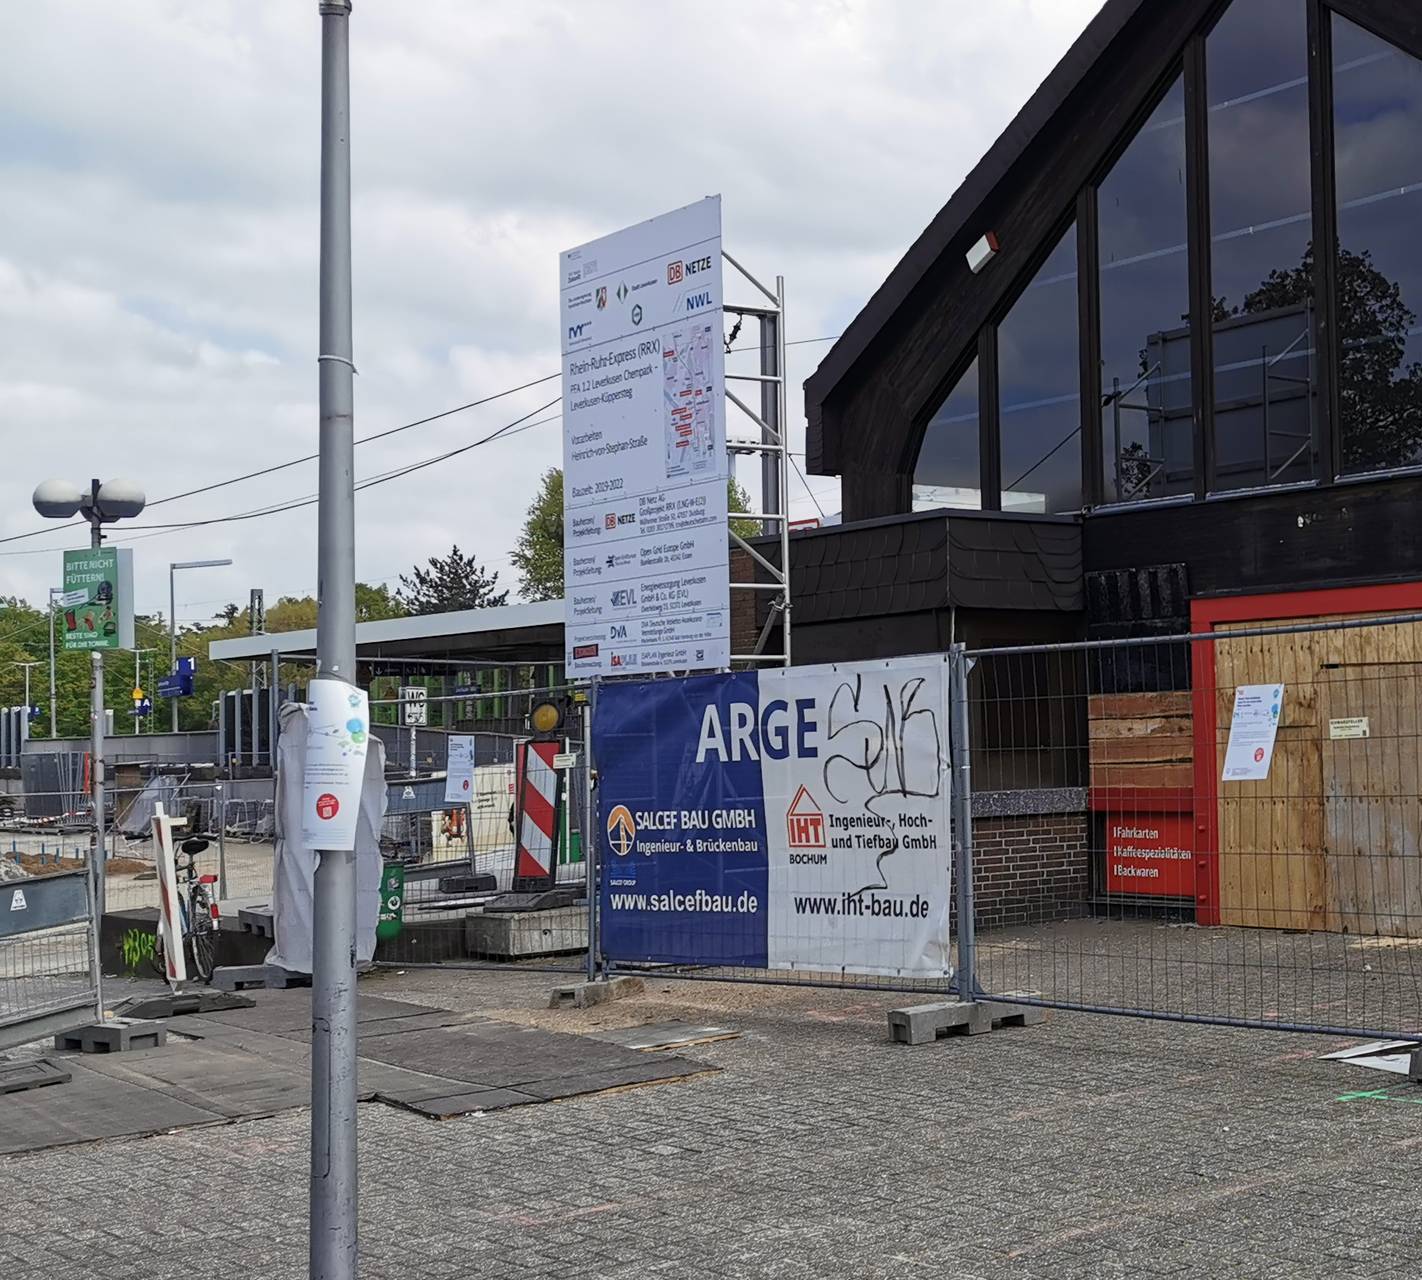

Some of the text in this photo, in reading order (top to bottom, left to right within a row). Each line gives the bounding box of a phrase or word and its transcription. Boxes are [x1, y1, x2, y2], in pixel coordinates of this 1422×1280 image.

[685, 256, 712, 276] NETZE
[686, 292, 712, 311] NWL
[570, 338, 660, 376] Rhein-Ruhr-Express (RRX)
[592, 374, 622, 390] Leverkusen
[624, 364, 653, 381] Chempark
[570, 388, 632, 412] Leverkusen-Küppersteg
[606, 514, 616, 528] DB
[618, 514, 636, 525] NETZE
[66, 560, 88, 571] BITTE
[66, 572, 104, 584] FÜTTERN!
[620, 589, 637, 606] EVL
[188, 657, 194, 670] 1
[408, 689, 424, 707] WC
[696, 698, 818, 762] ARGE
[636, 809, 756, 830] SALCEF BAU GMBH
[899, 813, 933, 828] Hoch-
[790, 818, 822, 843] IHT
[1117, 827, 1158, 839] Fahrkarten
[636, 839, 758, 856] Ingenieur- & Brückenbau
[831, 835, 937, 849] und Tiefbau GmbH
[790, 854, 827, 865] BOCHUM
[1118, 846, 1192, 861] Kaffeespezialitäten
[1118, 865, 1159, 877] Backwaren
[610, 890, 758, 913] www.salcefbau.de
[794, 893, 929, 918] www.iht-bau.de
